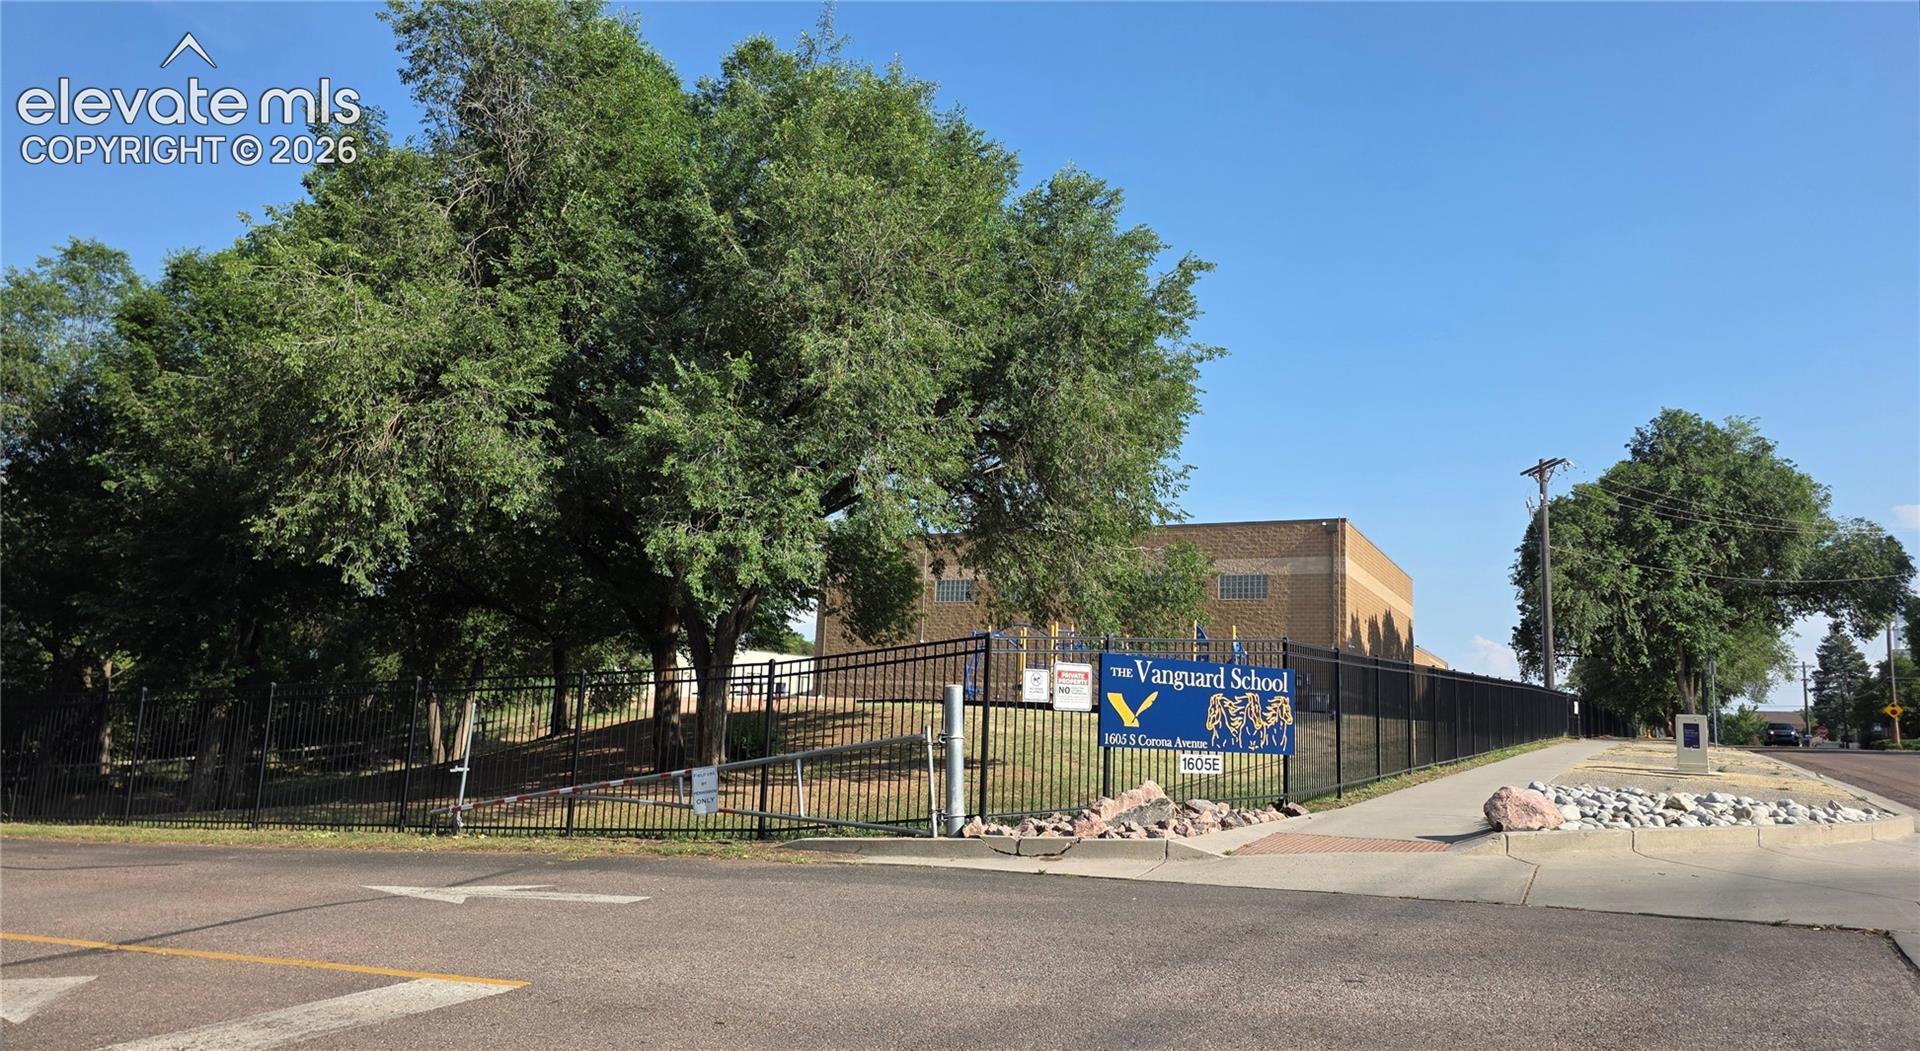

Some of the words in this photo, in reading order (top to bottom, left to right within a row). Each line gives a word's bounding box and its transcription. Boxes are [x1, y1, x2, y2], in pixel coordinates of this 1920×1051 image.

[1110, 666, 1134, 678] THE
[1134, 659, 1225, 691] Vanguard
[1230, 667, 1289, 693] School
[1058, 686, 1071, 695] NO
[1104, 732, 1127, 746] 1605
[1129, 734, 1136, 746] S
[1137, 734, 1172, 748] Corona
[1174, 736, 1208, 749] Avenue
[1182, 757, 1220, 771] 1605E
[696, 797, 715, 805] ONLY
